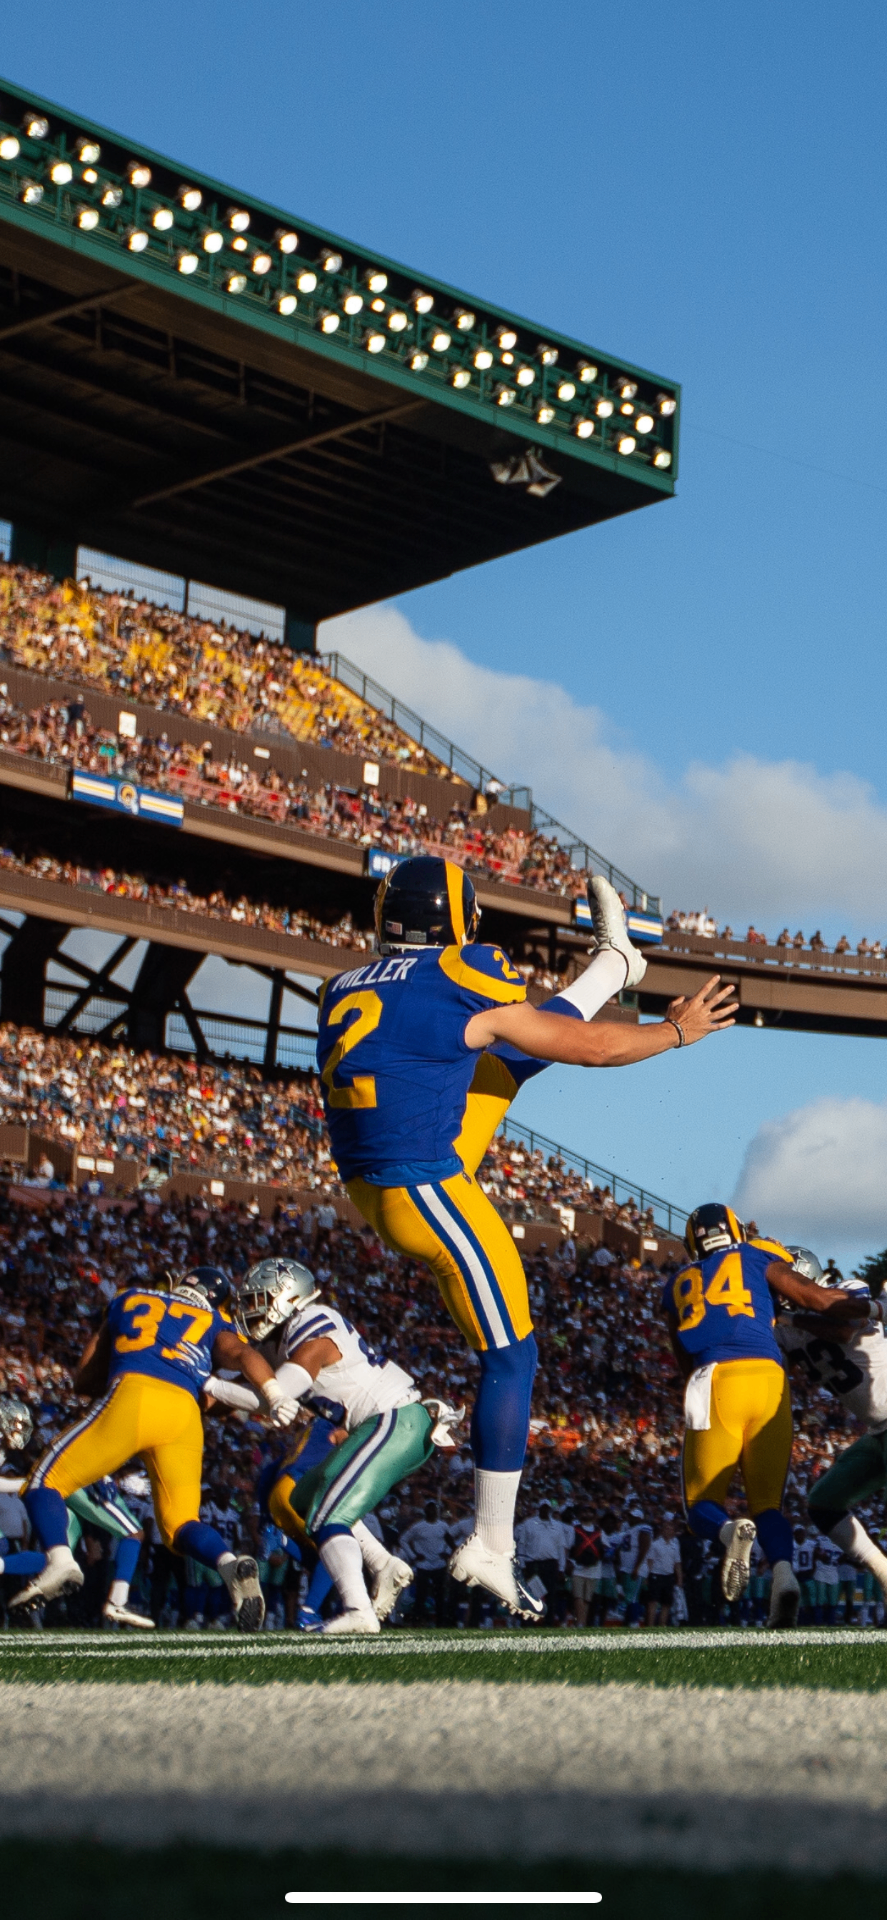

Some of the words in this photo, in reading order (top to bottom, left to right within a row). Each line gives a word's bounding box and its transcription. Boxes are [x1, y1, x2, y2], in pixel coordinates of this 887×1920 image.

[331, 957, 418, 992] MILLER
[493, 950, 520, 980] 2
[322, 990, 383, 1108] 2
[673, 1252, 755, 1331] 84
[115, 1294, 213, 1360] 37
